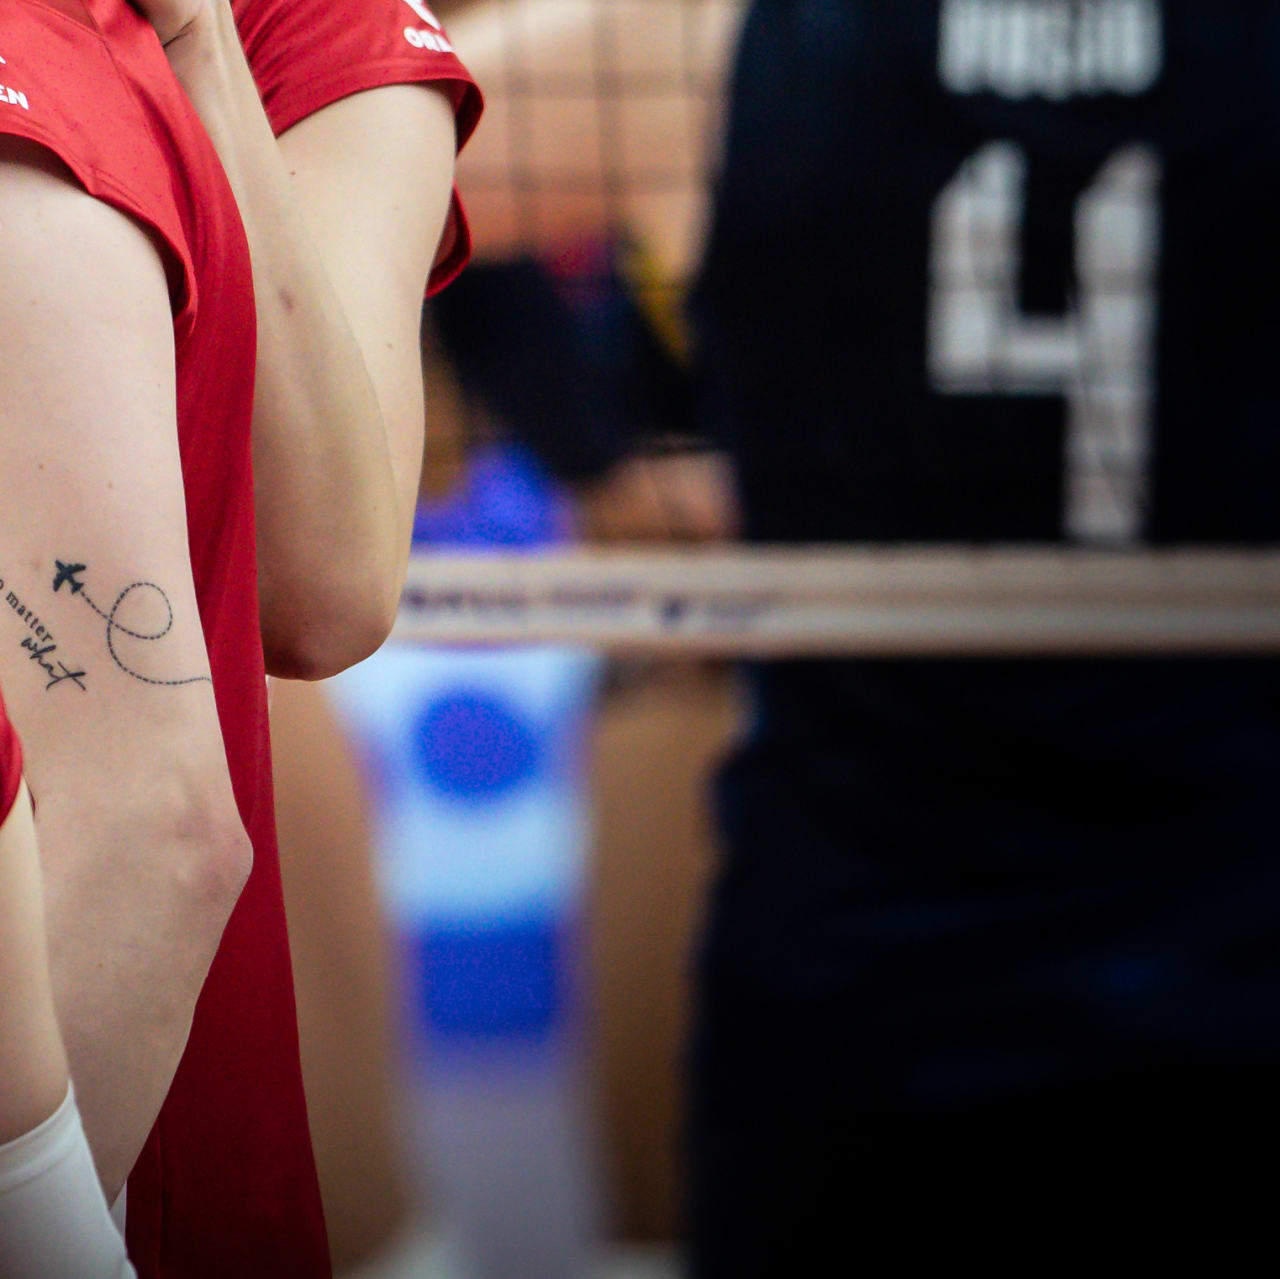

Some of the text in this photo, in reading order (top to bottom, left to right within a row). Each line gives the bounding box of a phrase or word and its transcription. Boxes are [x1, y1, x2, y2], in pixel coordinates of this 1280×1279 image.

[930, 140, 1163, 542] 4
[6, 591, 54, 642] matter
[20, 637, 87, 691] what
